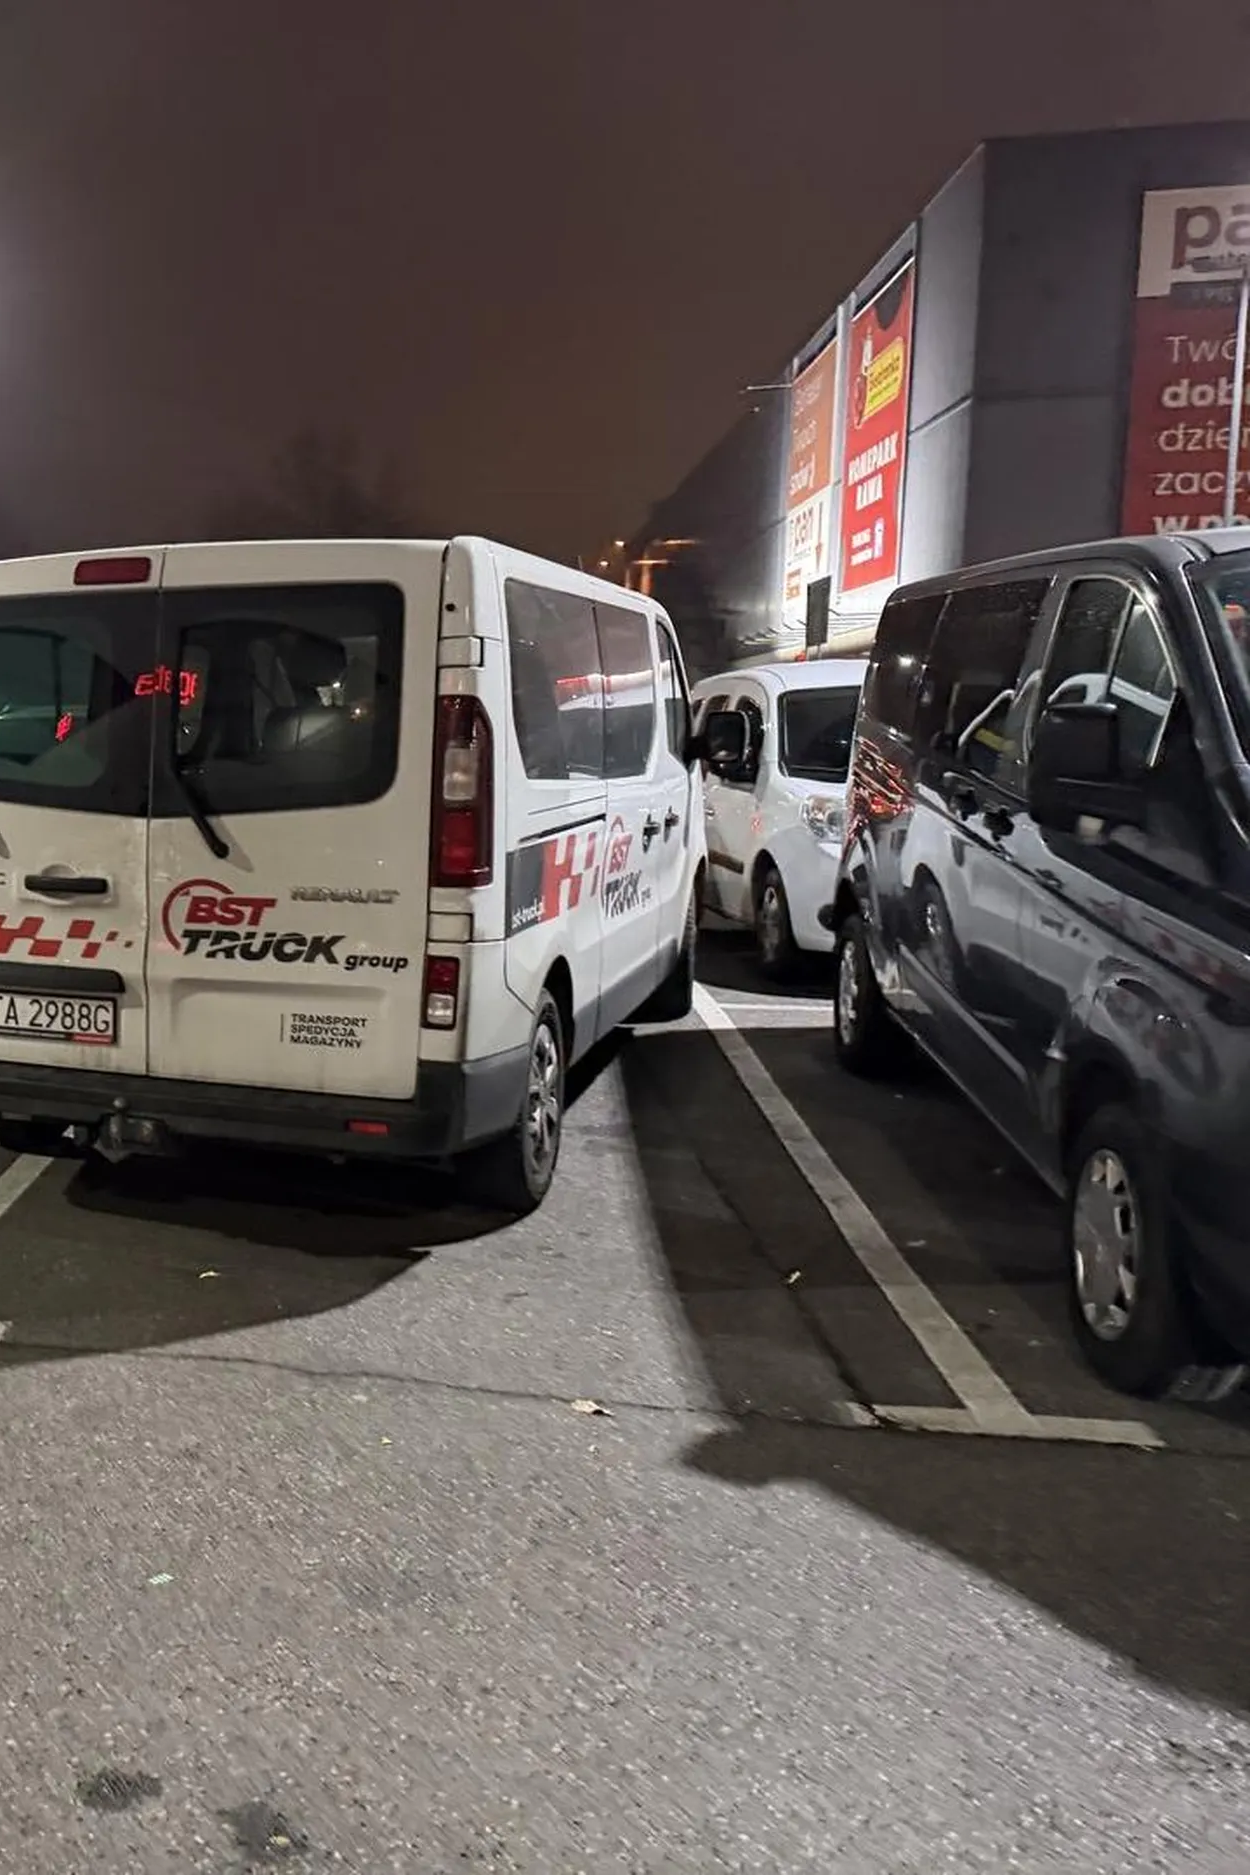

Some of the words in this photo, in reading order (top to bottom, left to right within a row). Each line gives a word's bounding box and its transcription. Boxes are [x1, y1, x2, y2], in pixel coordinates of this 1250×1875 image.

[1163, 332, 1250, 370] Twó
[1161, 377, 1250, 410] dob
[184, 896, 278, 927] BST
[181, 928, 347, 965] TRUCK
[344, 952, 409, 973] group
[28, 999, 111, 1034] 2988G
[290, 1012, 368, 1029] TRANSPORT
[290, 1024, 357, 1038] SPEDYCJA
[290, 1036, 363, 1050] MAGAZYNY
